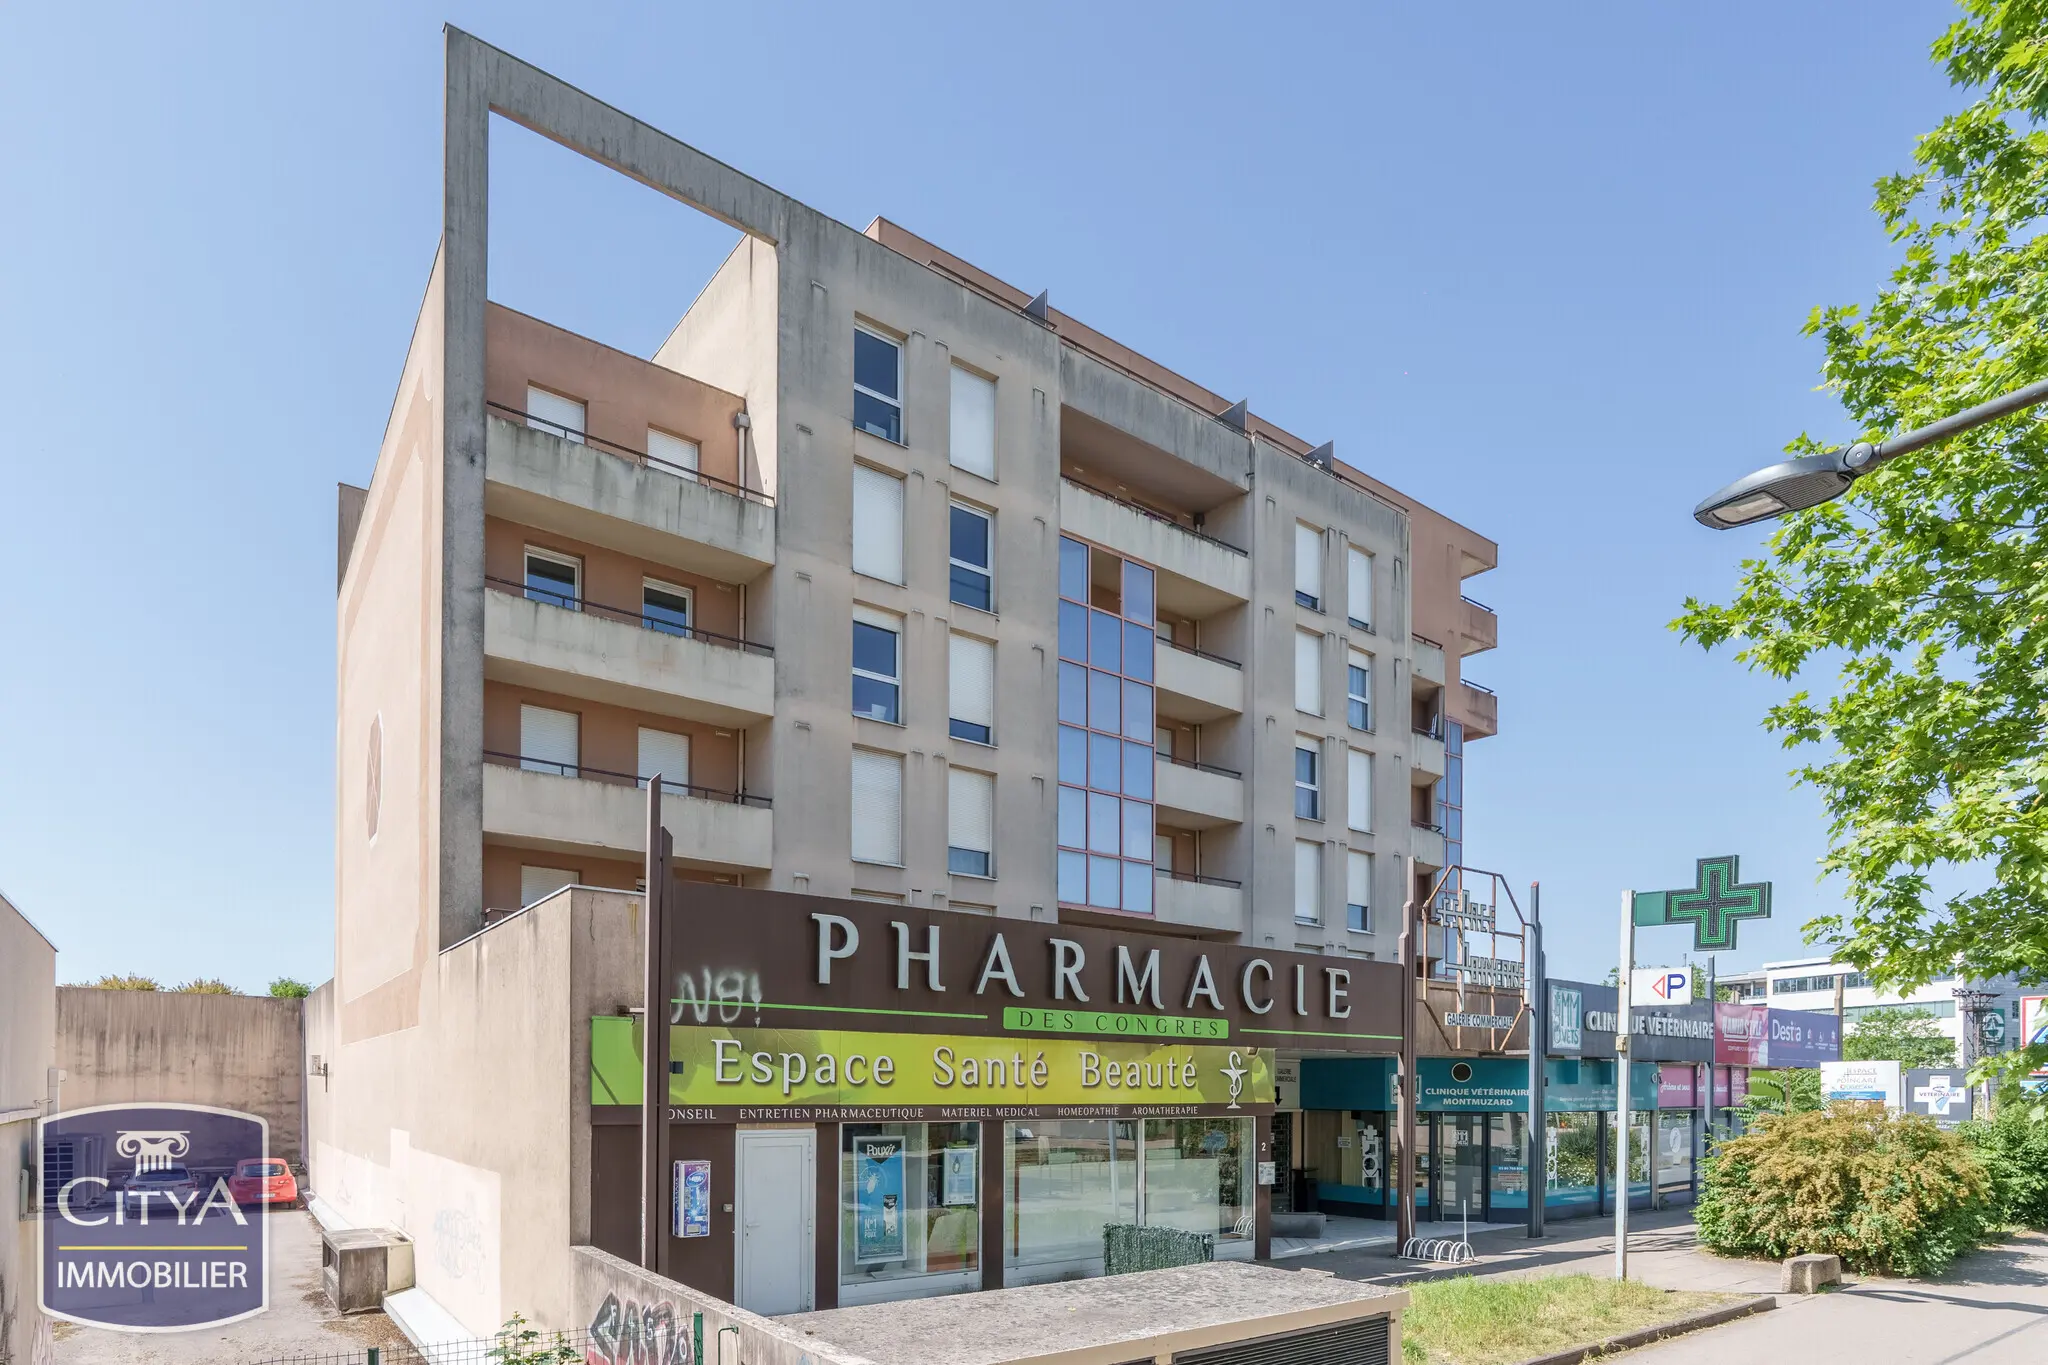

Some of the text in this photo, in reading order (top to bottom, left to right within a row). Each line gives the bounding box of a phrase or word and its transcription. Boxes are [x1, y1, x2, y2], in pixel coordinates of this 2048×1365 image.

[811, 912, 1352, 1019] PHARMACIE
[1667, 974, 1686, 999] P
[1018, 1010, 1219, 1036] DES CONGRES
[1447, 1013, 1513, 1028] GALERIE COMMERCIALE
[1586, 1011, 1714, 1039] CLINUE VÉTÉRINAIRE
[711, 1039, 1198, 1095] Espace Santé Beauté
[1425, 1088, 1469, 1096] CLINIQUE
[1443, 1098, 1513, 1106] MONTMUZARD
[668, 1106, 1198, 1120] ONSEIL ENTRETIEN PHARMACEUTIQUE MATERIEL MEDICAL HOMEOPATHIE AROMATHERAPIE
[1261, 1142, 1266, 1151] 2
